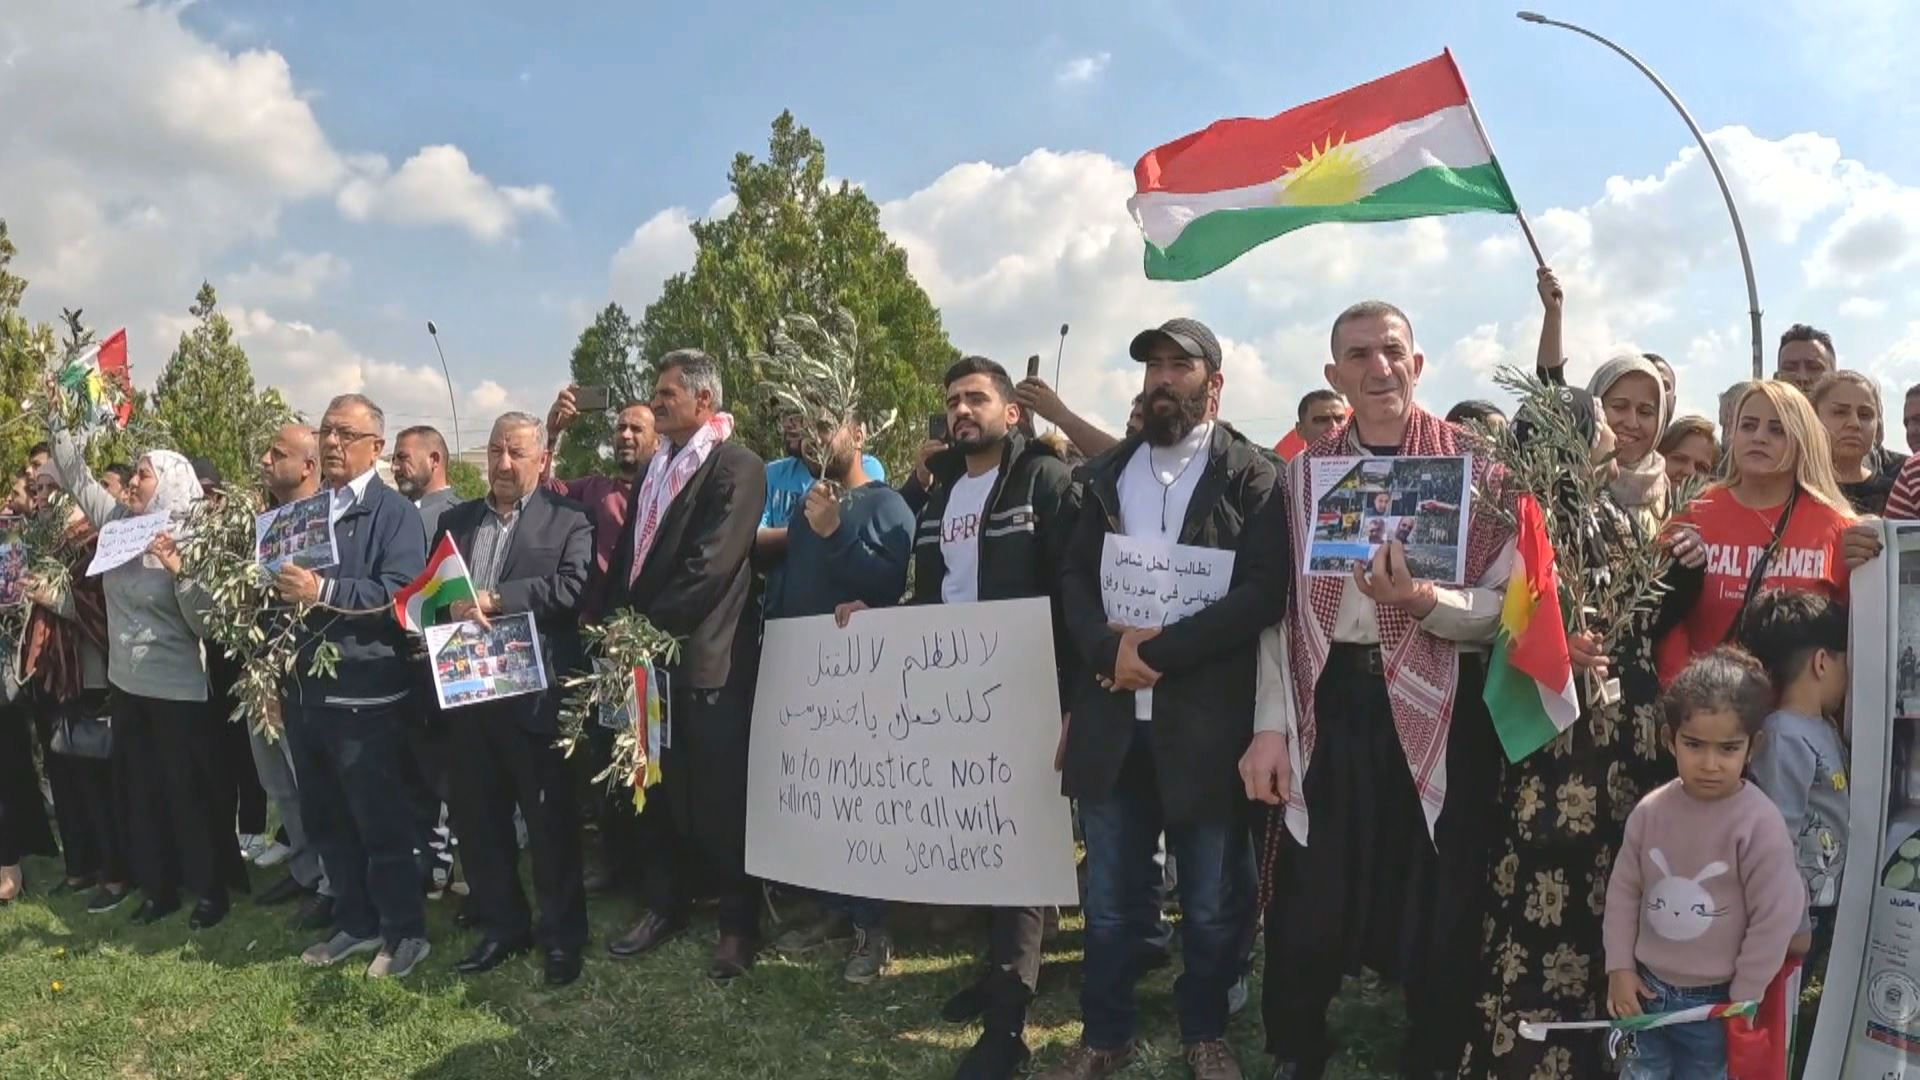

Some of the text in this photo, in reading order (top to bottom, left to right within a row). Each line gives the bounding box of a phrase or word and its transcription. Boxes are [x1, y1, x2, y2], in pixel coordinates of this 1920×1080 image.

[1115, 551, 1143, 567] شامل
[1146, 555, 1170, 572] لحل
[1123, 578, 1156, 597] سوريا
[1160, 583, 1178, 605] في
[807, 627, 999, 699] لا للظلم لا للقتل
[944, 683, 1002, 723] كلنا
[875, 799, 914, 826] are
[920, 795, 949, 829] all
